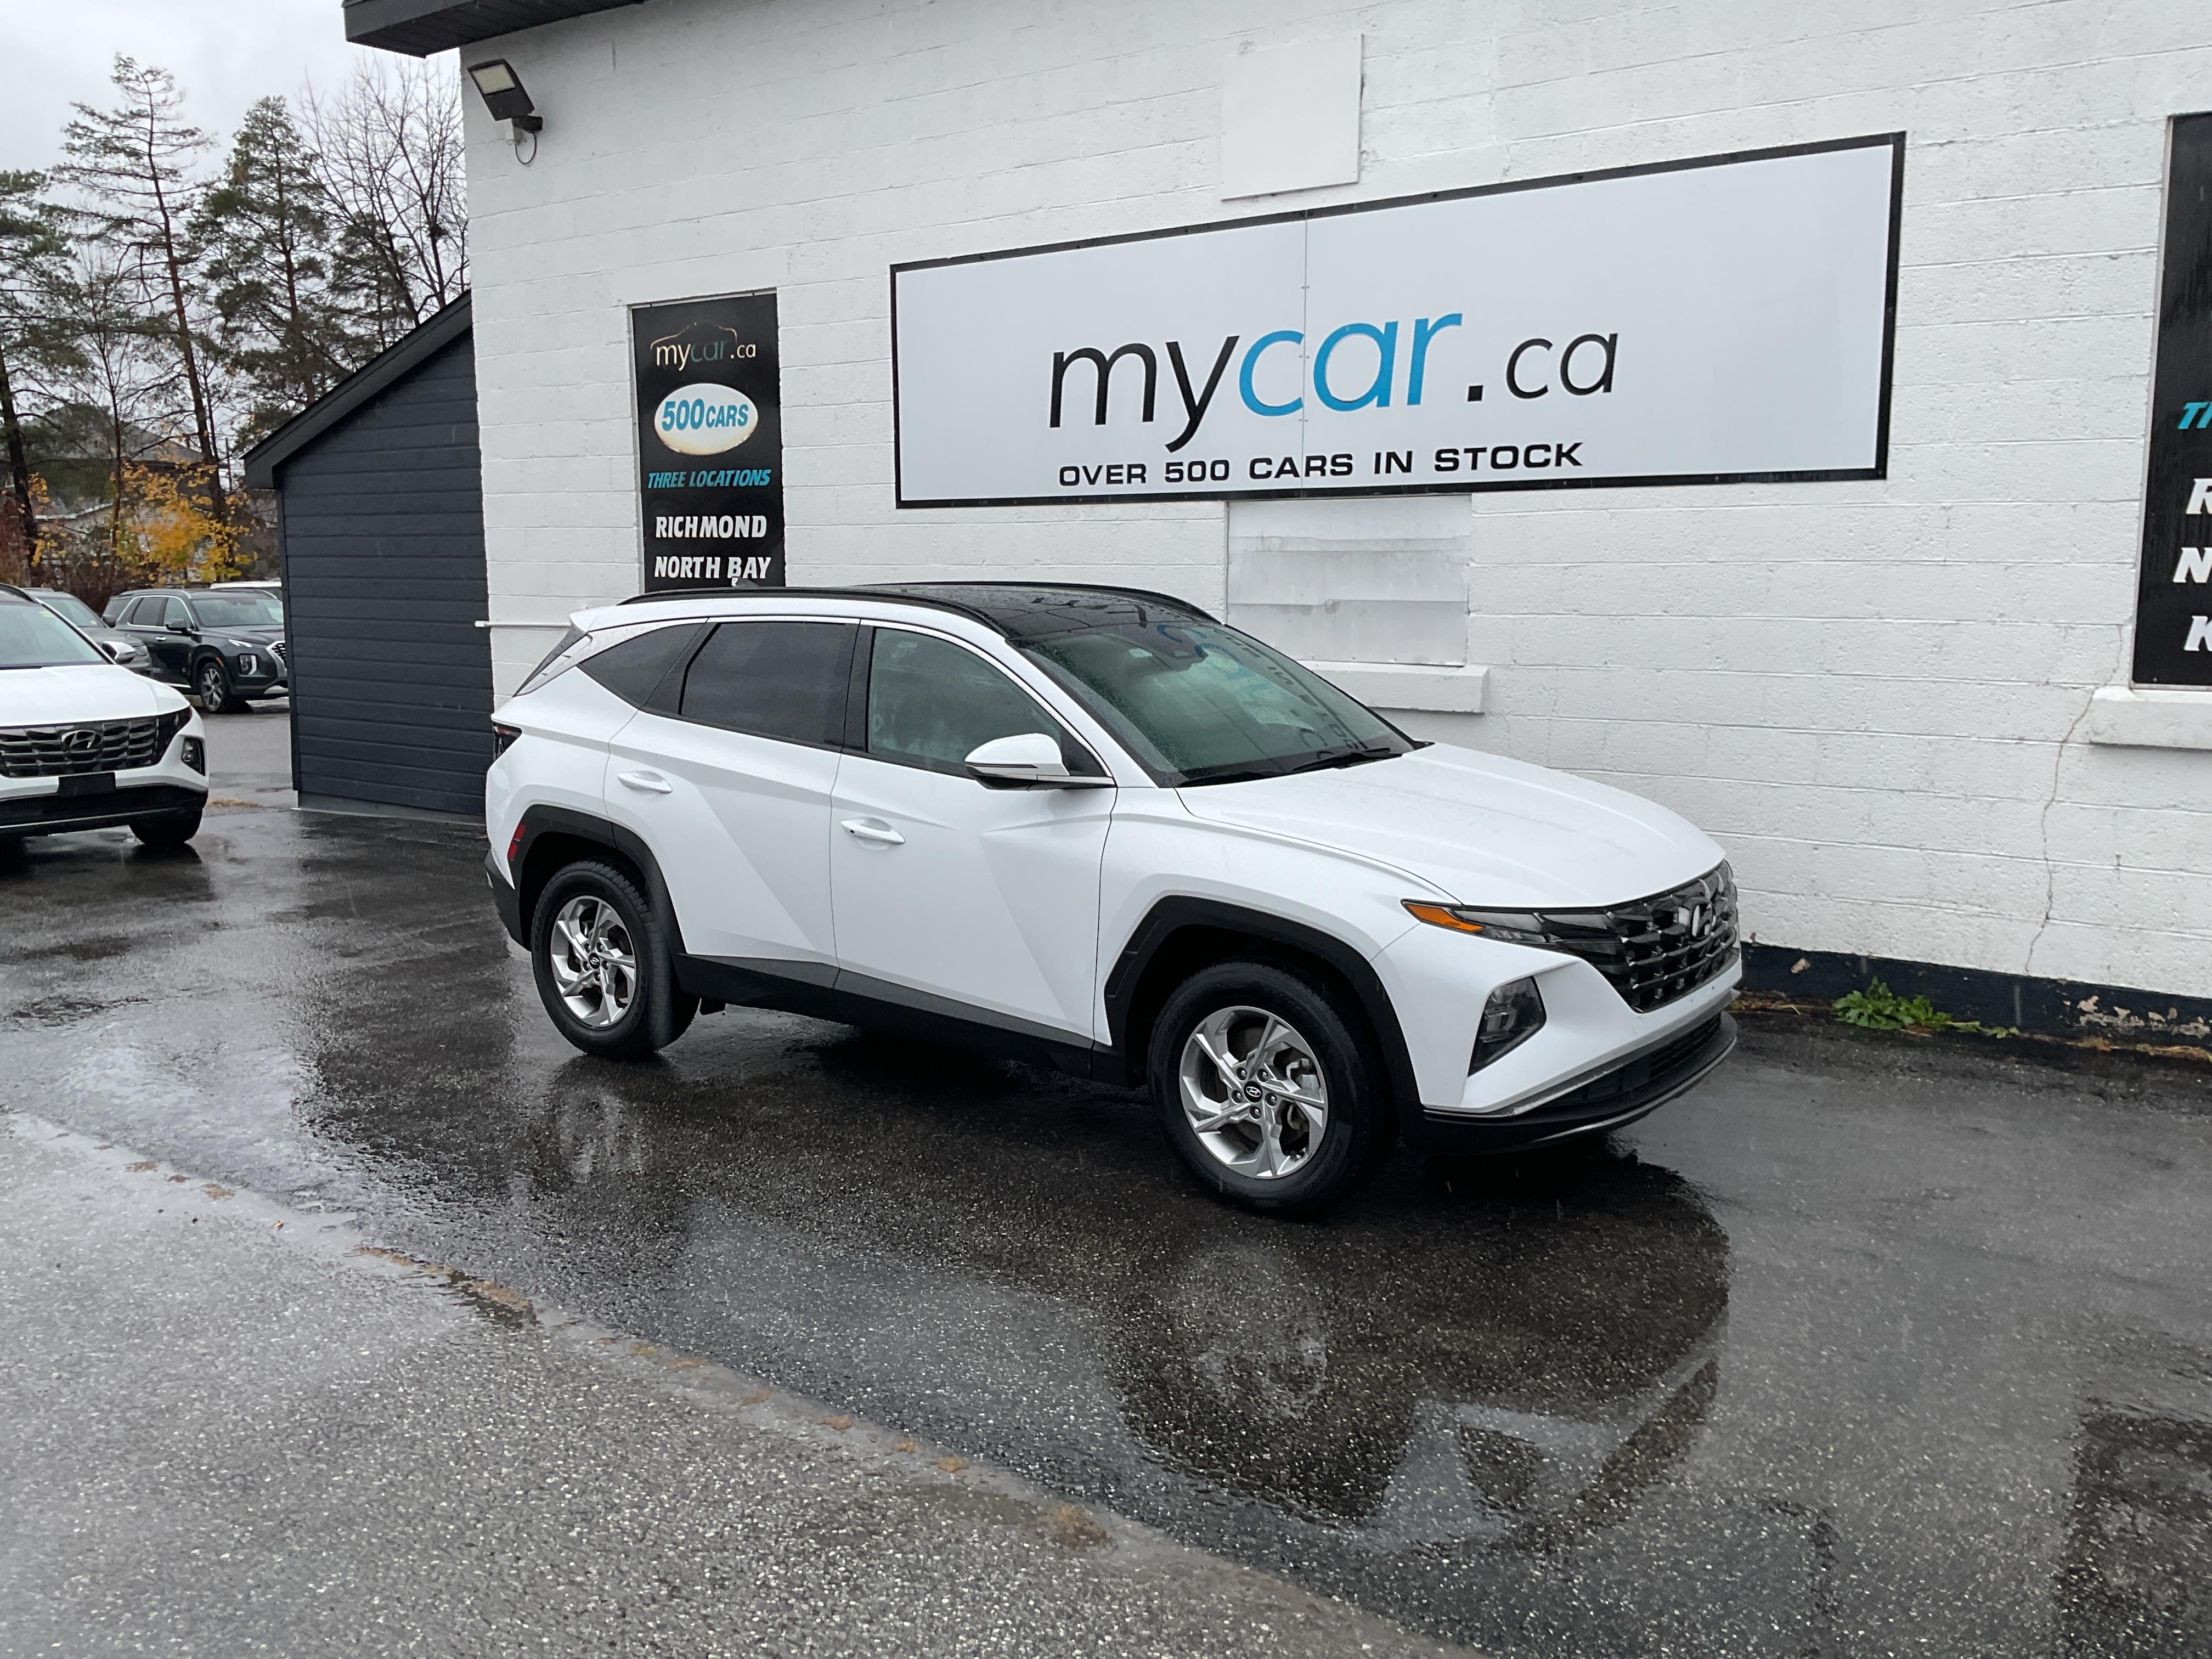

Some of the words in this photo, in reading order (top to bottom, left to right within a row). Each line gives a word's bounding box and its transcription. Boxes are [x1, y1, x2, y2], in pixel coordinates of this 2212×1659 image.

[1049, 313, 1619, 454] mycar.ca
[1059, 463, 1147, 487] OVER
[1164, 459, 1230, 483] 500
[1249, 453, 1353, 479] CARS
[1374, 450, 1413, 475] IN
[1434, 442, 1584, 472] STOCK
[647, 471, 687, 489] THREE
[689, 469, 772, 488] LOCATIONS
[656, 515, 768, 538] RICHMOND
[654, 556, 721, 578] NORTH
[727, 556, 772, 579] BAY
